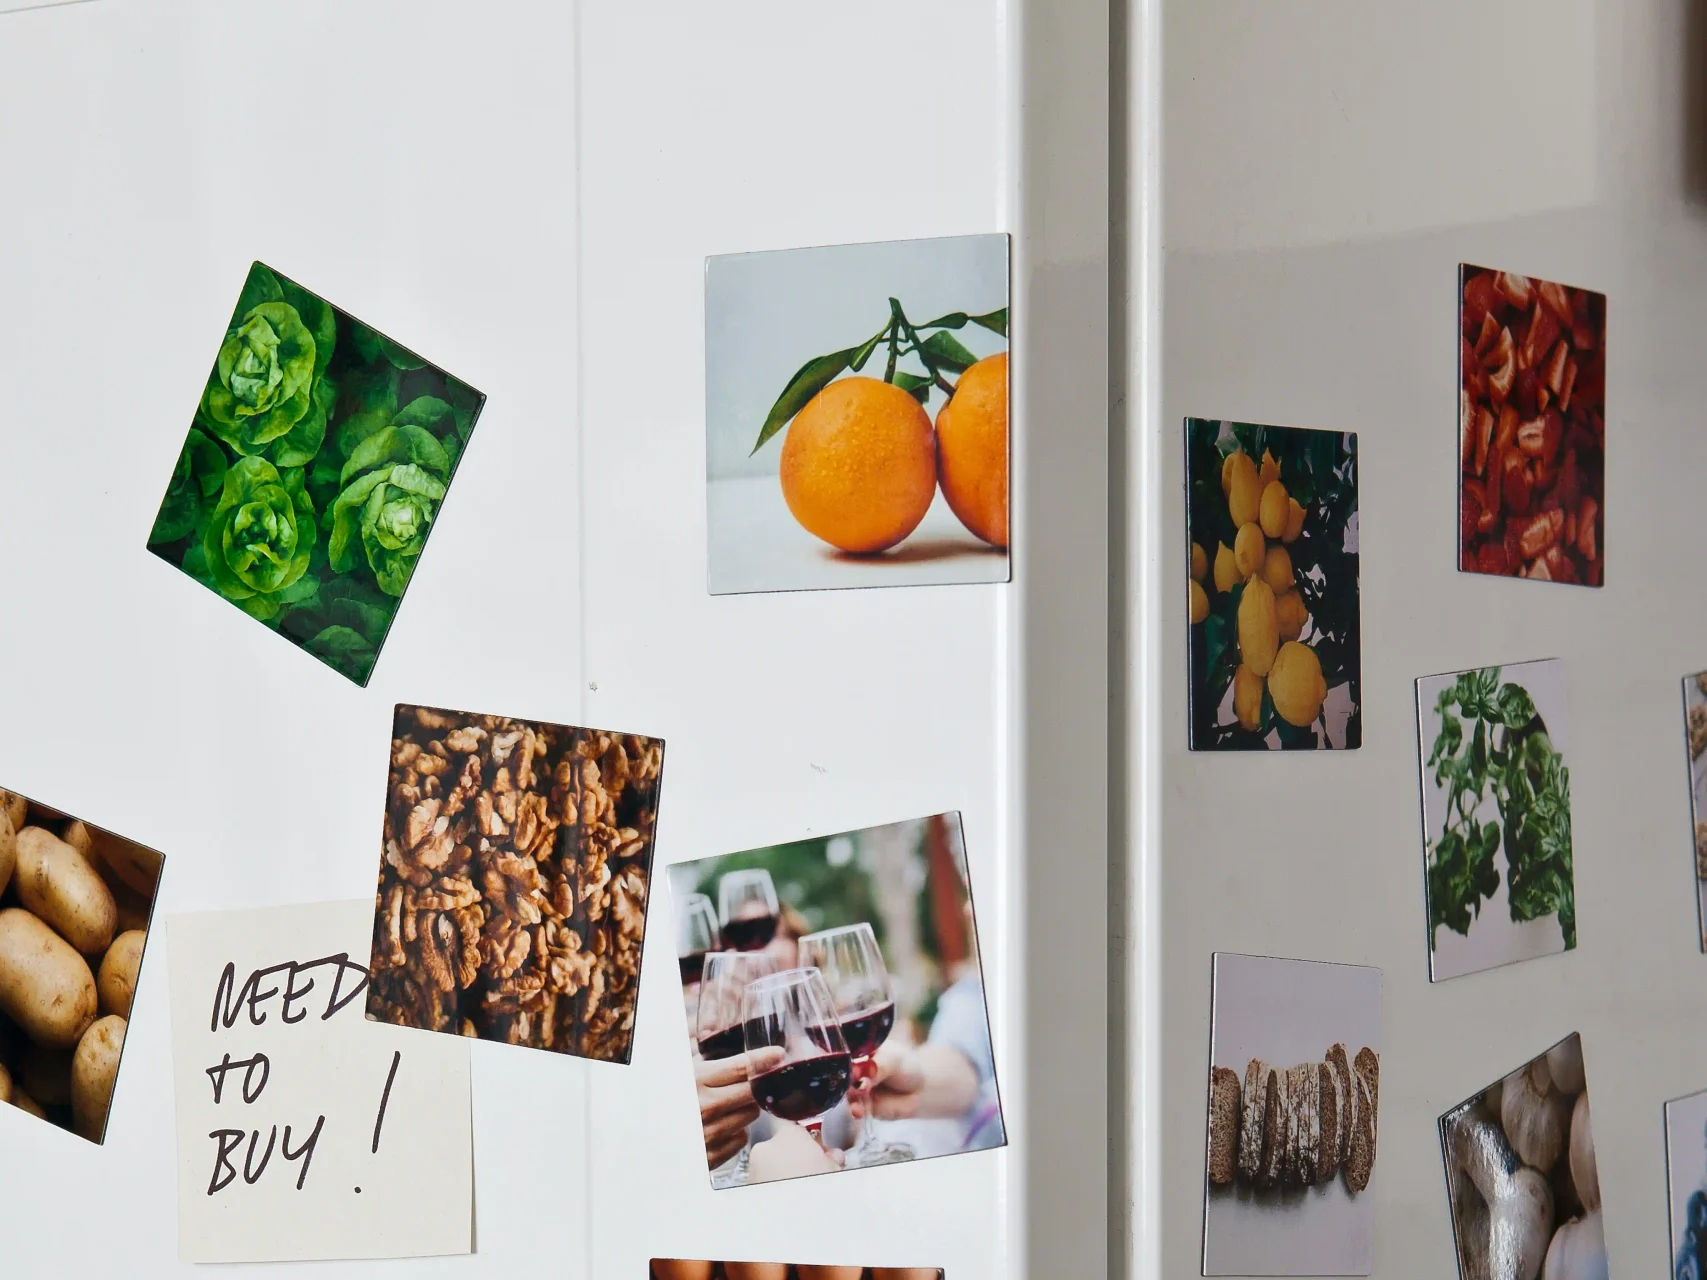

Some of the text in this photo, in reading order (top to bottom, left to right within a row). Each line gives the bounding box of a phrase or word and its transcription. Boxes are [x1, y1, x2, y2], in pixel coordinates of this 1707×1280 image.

[210, 952, 370, 1032] NEED
[205, 1052, 270, 1105] TO
[207, 1114, 326, 1196] BUY
